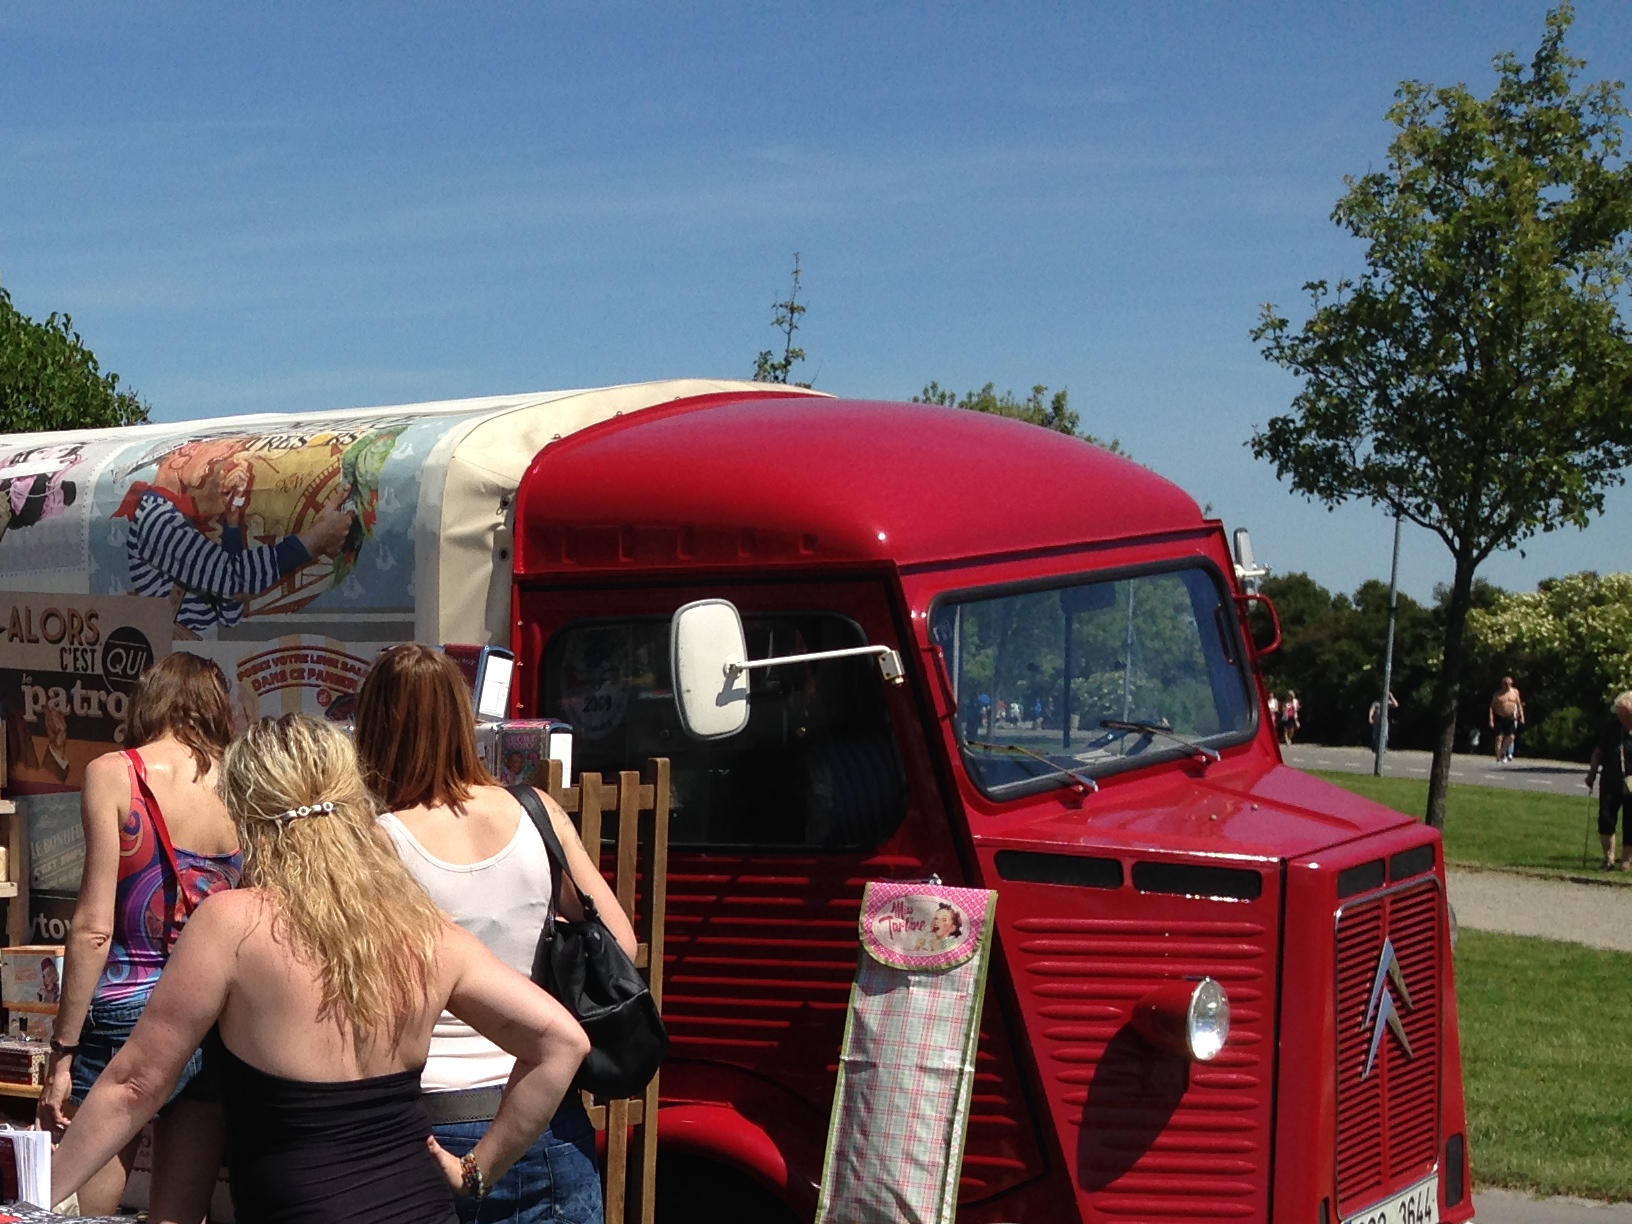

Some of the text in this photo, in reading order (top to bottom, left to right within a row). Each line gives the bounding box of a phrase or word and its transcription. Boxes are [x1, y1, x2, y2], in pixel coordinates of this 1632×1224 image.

[60, 647, 97, 672] C'EST
[106, 648, 147, 675] QUI
[21, 679, 130, 722] patro
[891, 900, 914, 920] Miss
[879, 915, 926, 940] Tartine
